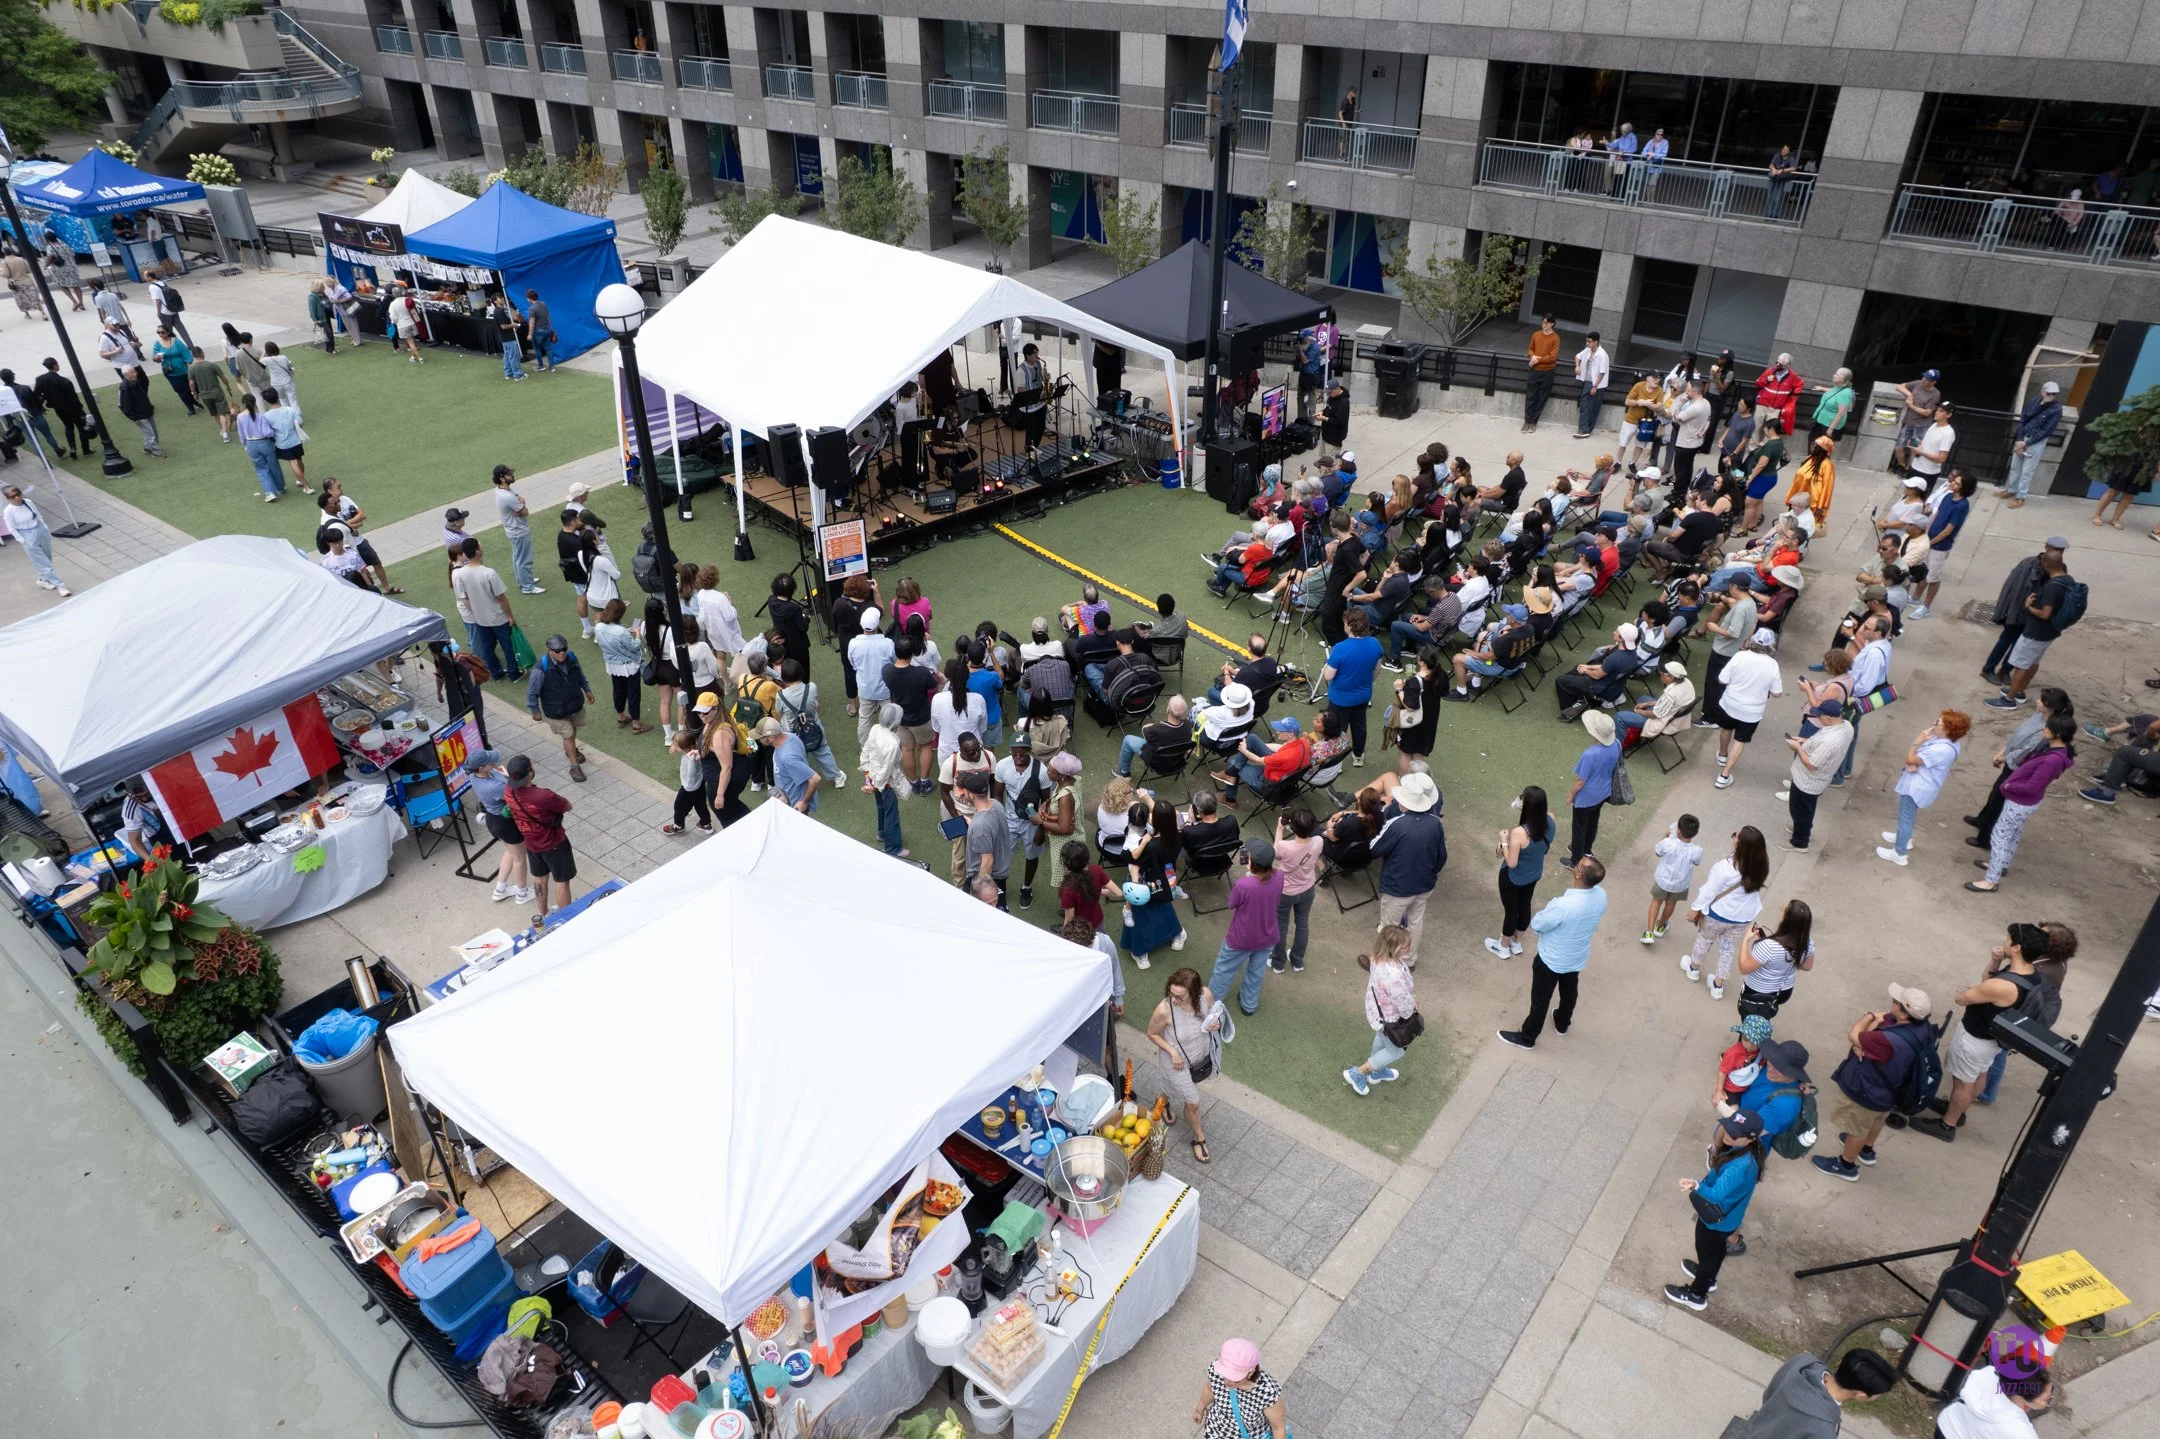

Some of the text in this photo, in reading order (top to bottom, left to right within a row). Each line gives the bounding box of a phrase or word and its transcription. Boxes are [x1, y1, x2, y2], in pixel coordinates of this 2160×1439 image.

[115, 182, 164, 198] TORONTO
[96, 191, 189, 212] www.toronto.ca/water
[2042, 1275, 2098, 1299] XTREME BOX
